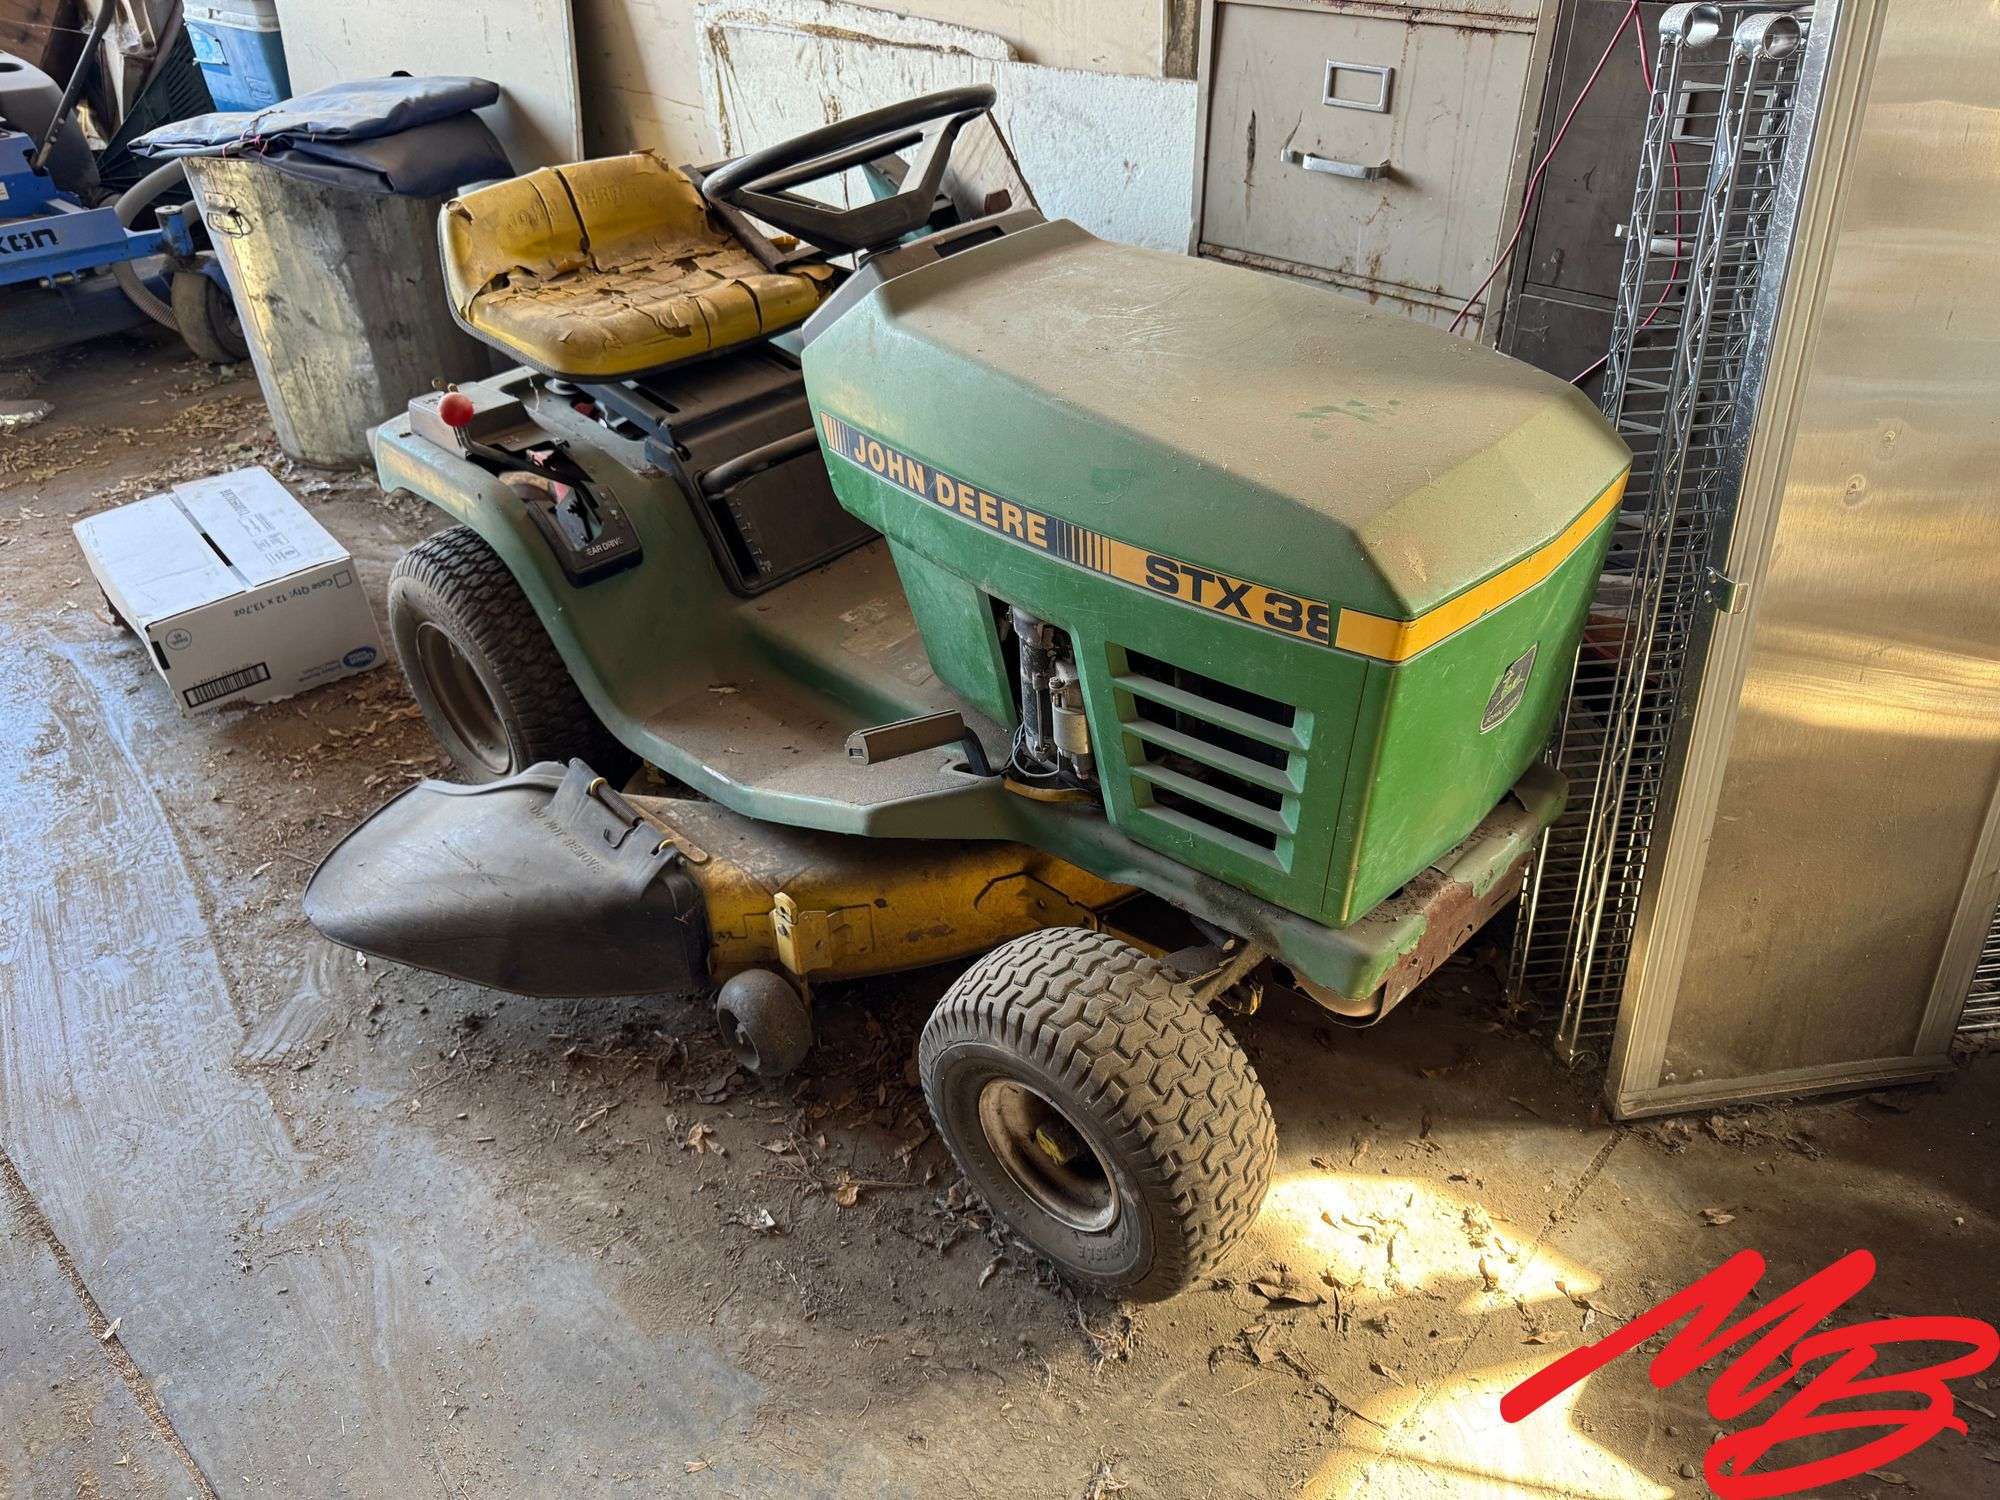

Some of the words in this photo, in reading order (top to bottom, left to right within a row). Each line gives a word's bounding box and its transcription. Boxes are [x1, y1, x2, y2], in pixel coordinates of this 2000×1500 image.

[854, 435, 926, 495] JOHN
[935, 472, 1048, 549] DEERE
[276, 594, 288, 604] 12
[311, 578, 334, 590] Case
[1145, 554, 1253, 620] STX
[1263, 592, 1330, 642] 38
